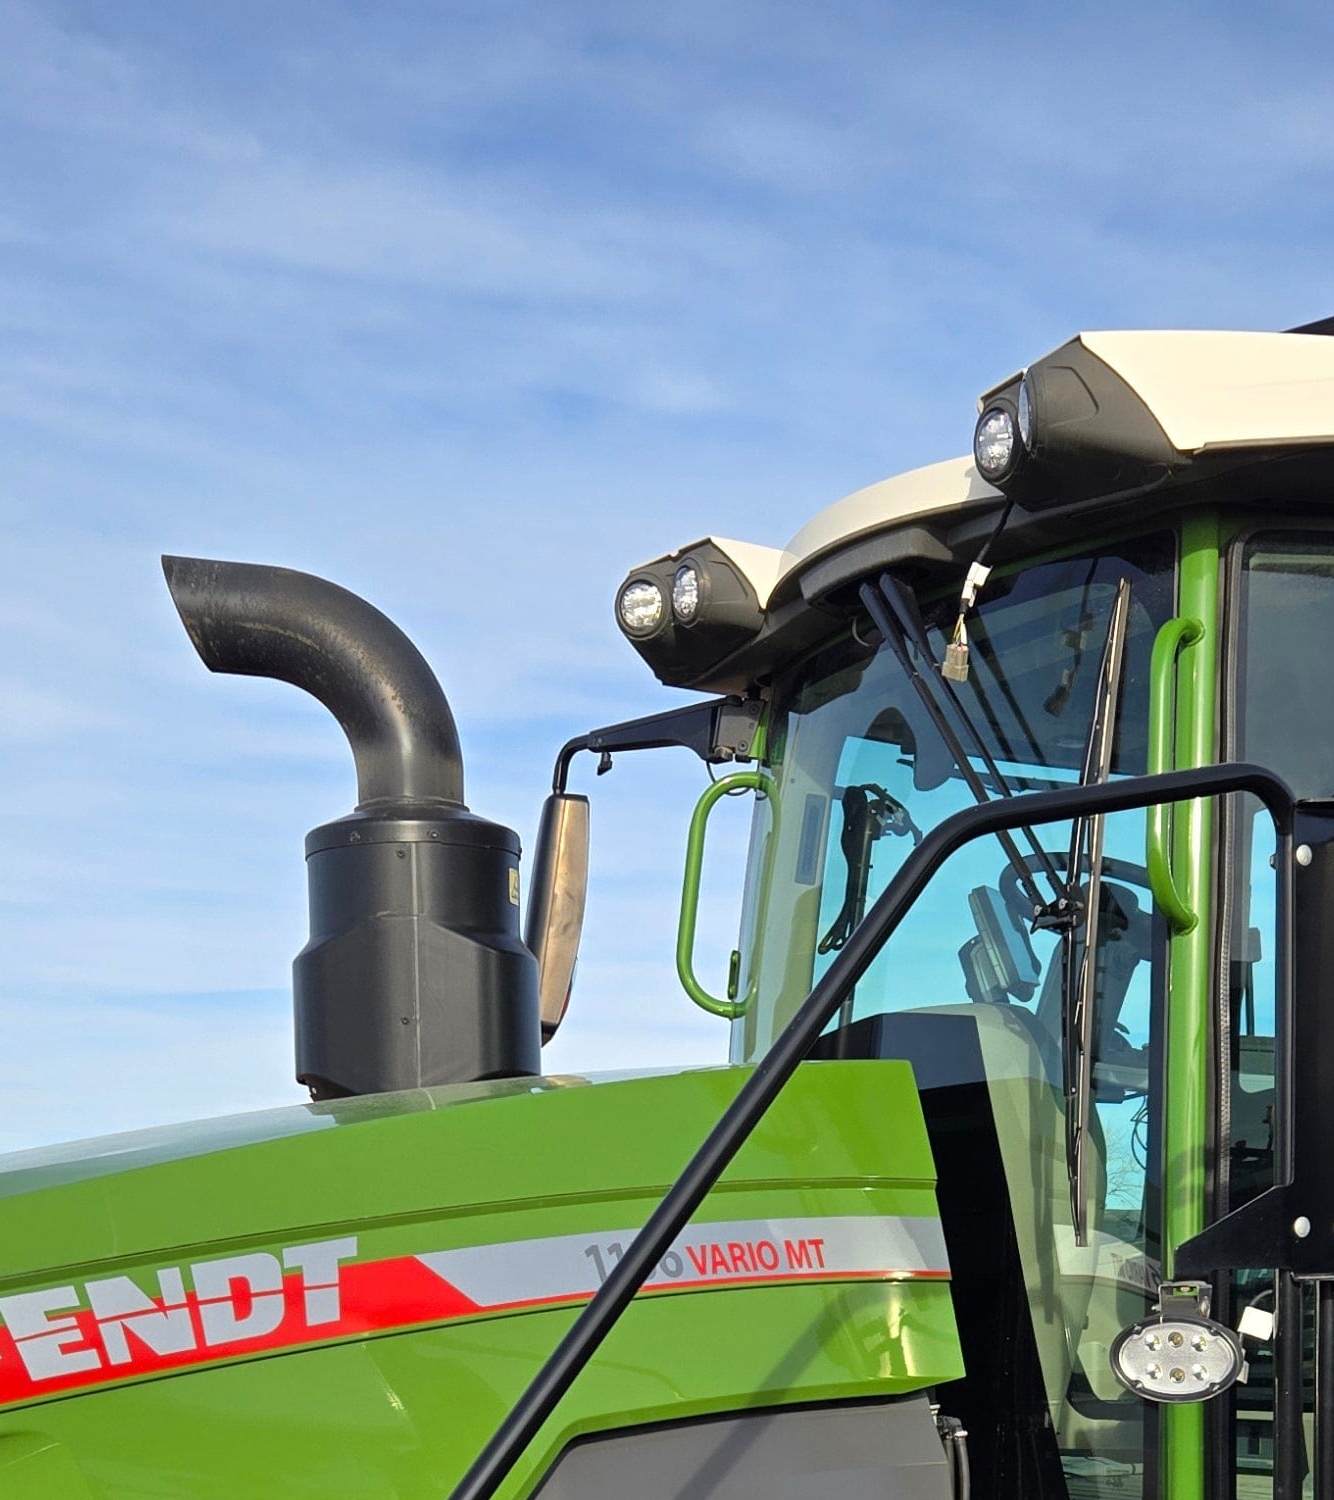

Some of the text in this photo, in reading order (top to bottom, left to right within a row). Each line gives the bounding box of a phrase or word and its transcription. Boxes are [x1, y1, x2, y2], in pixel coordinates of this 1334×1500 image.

[585, 1238, 825, 1284] 116 VARIO MT
